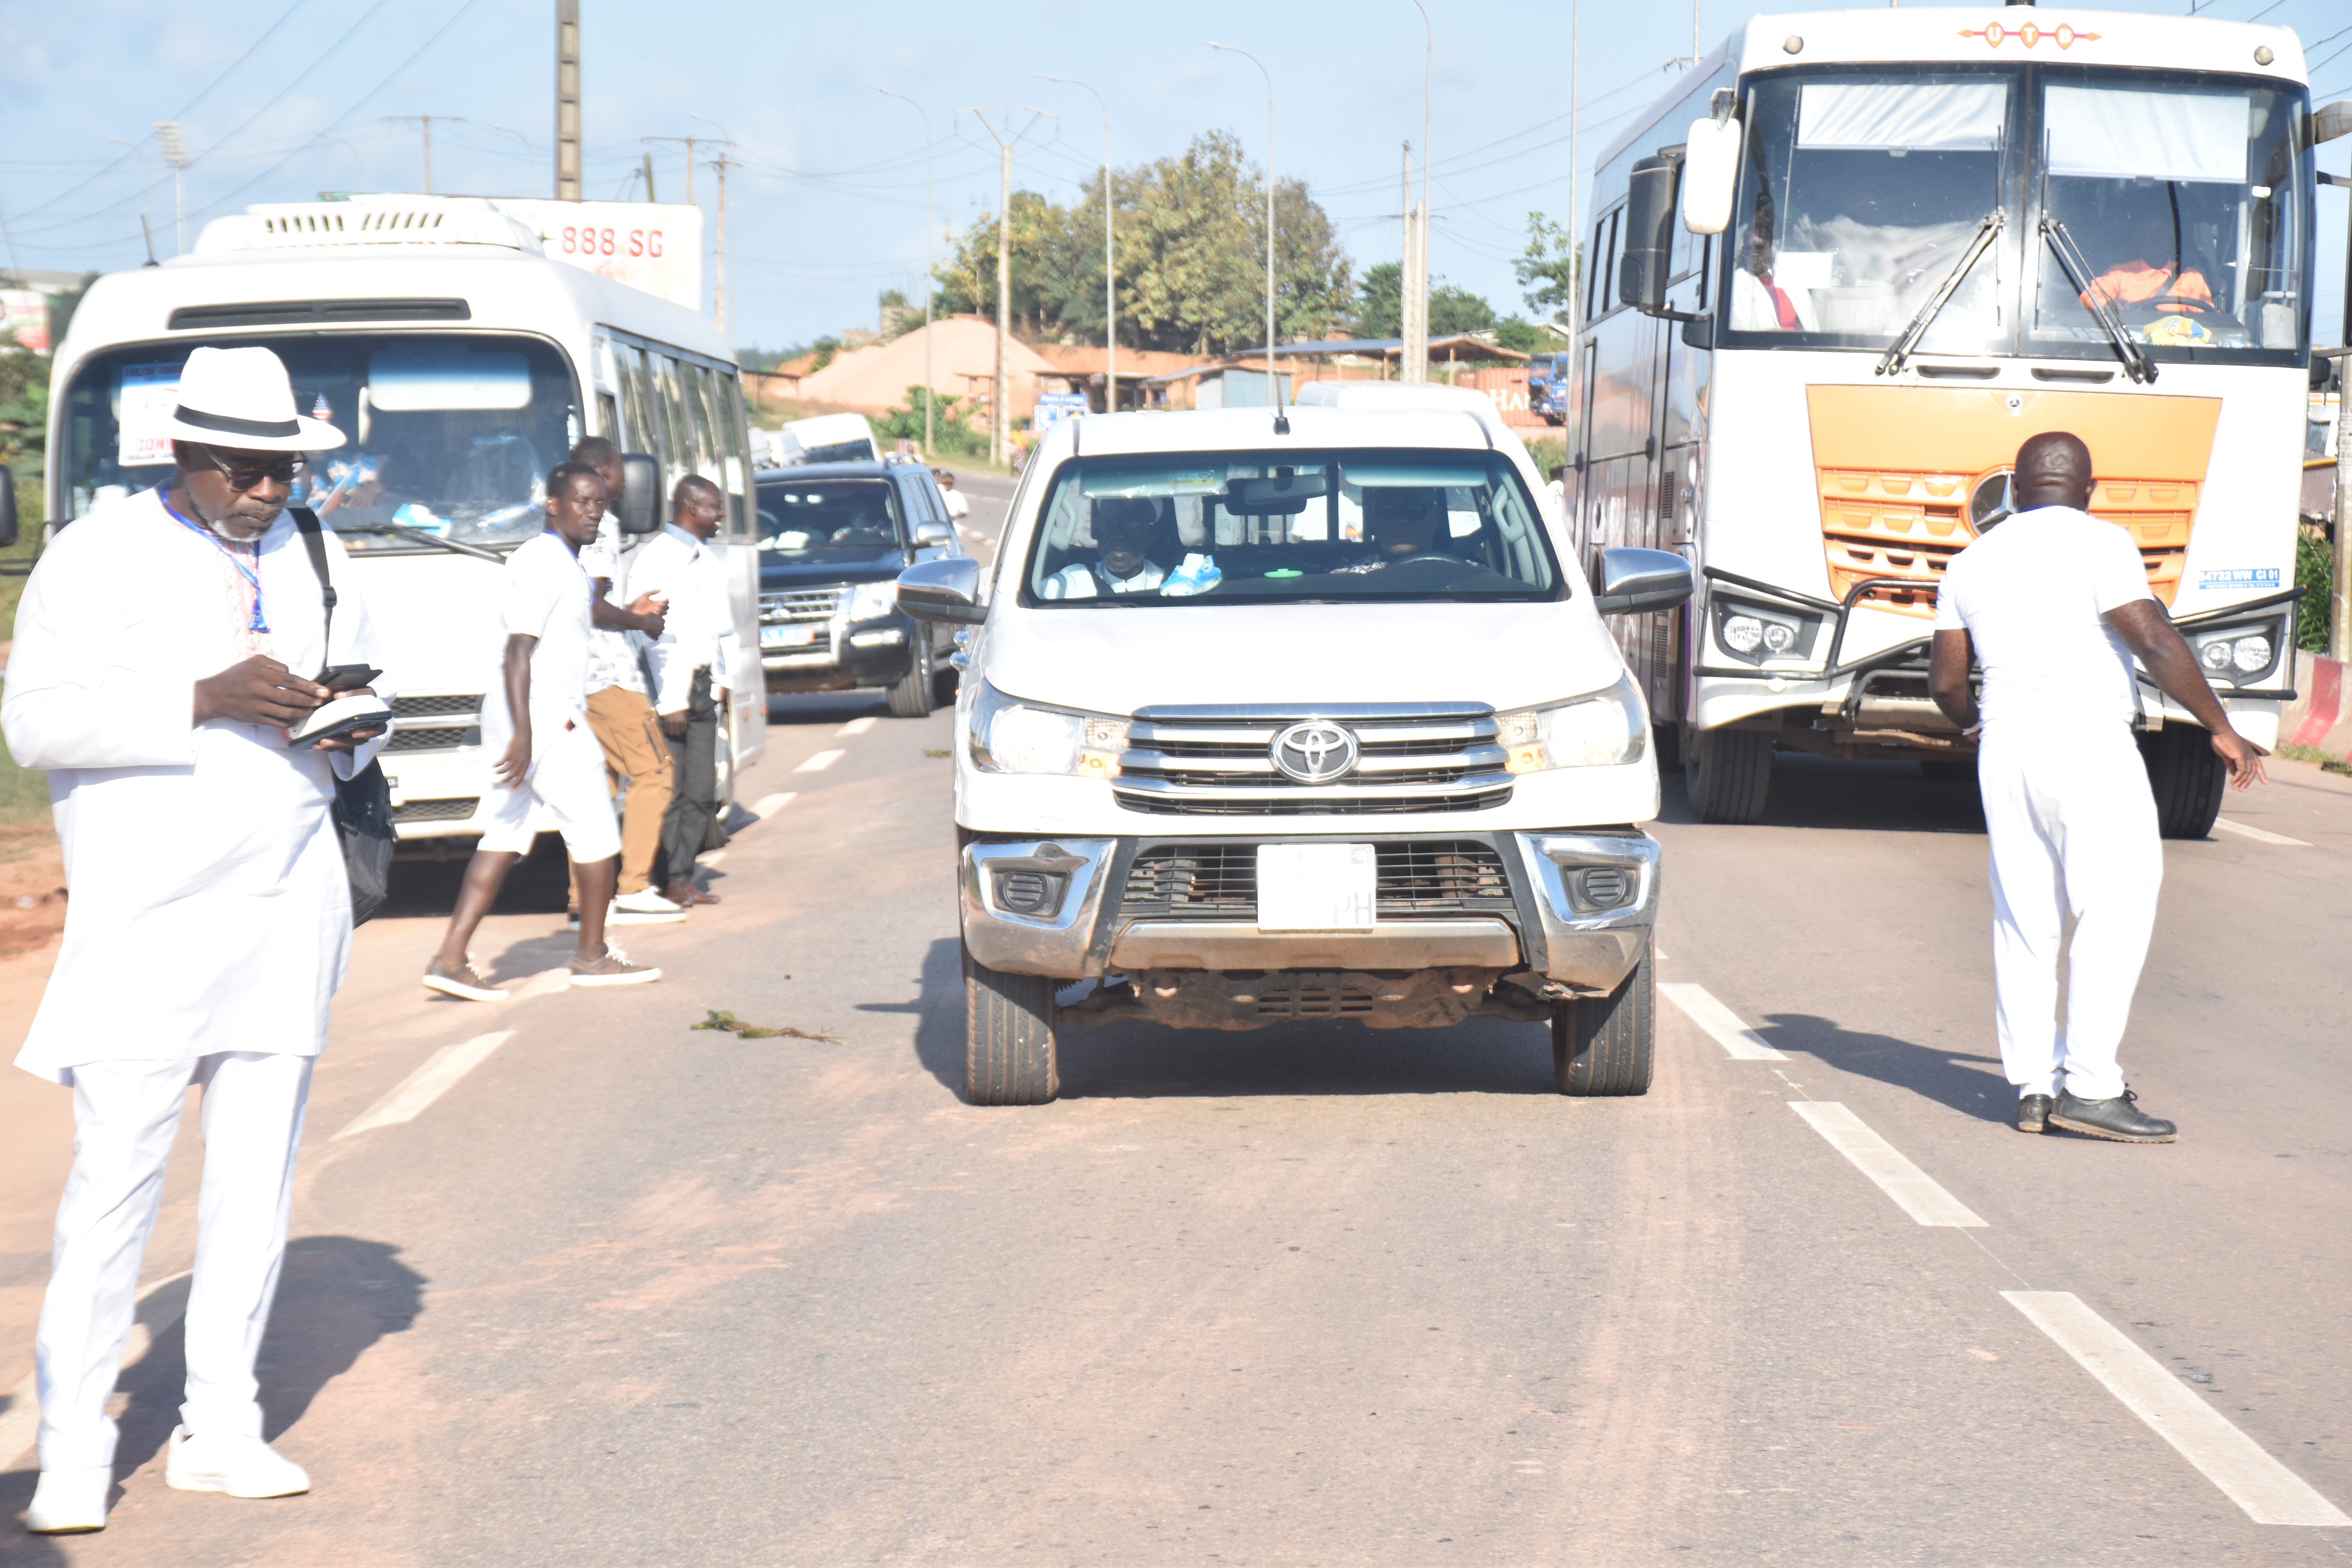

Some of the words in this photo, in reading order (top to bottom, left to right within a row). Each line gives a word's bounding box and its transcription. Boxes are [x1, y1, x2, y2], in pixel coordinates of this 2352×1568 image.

[1988, 27, 2072, 43] UTB
[562, 225, 615, 256] 888
[628, 229, 662, 258] SG
[2232, 570, 2252, 580] WW
[2256, 570, 2267, 580] CI
[2268, 569, 2278, 579] 01
